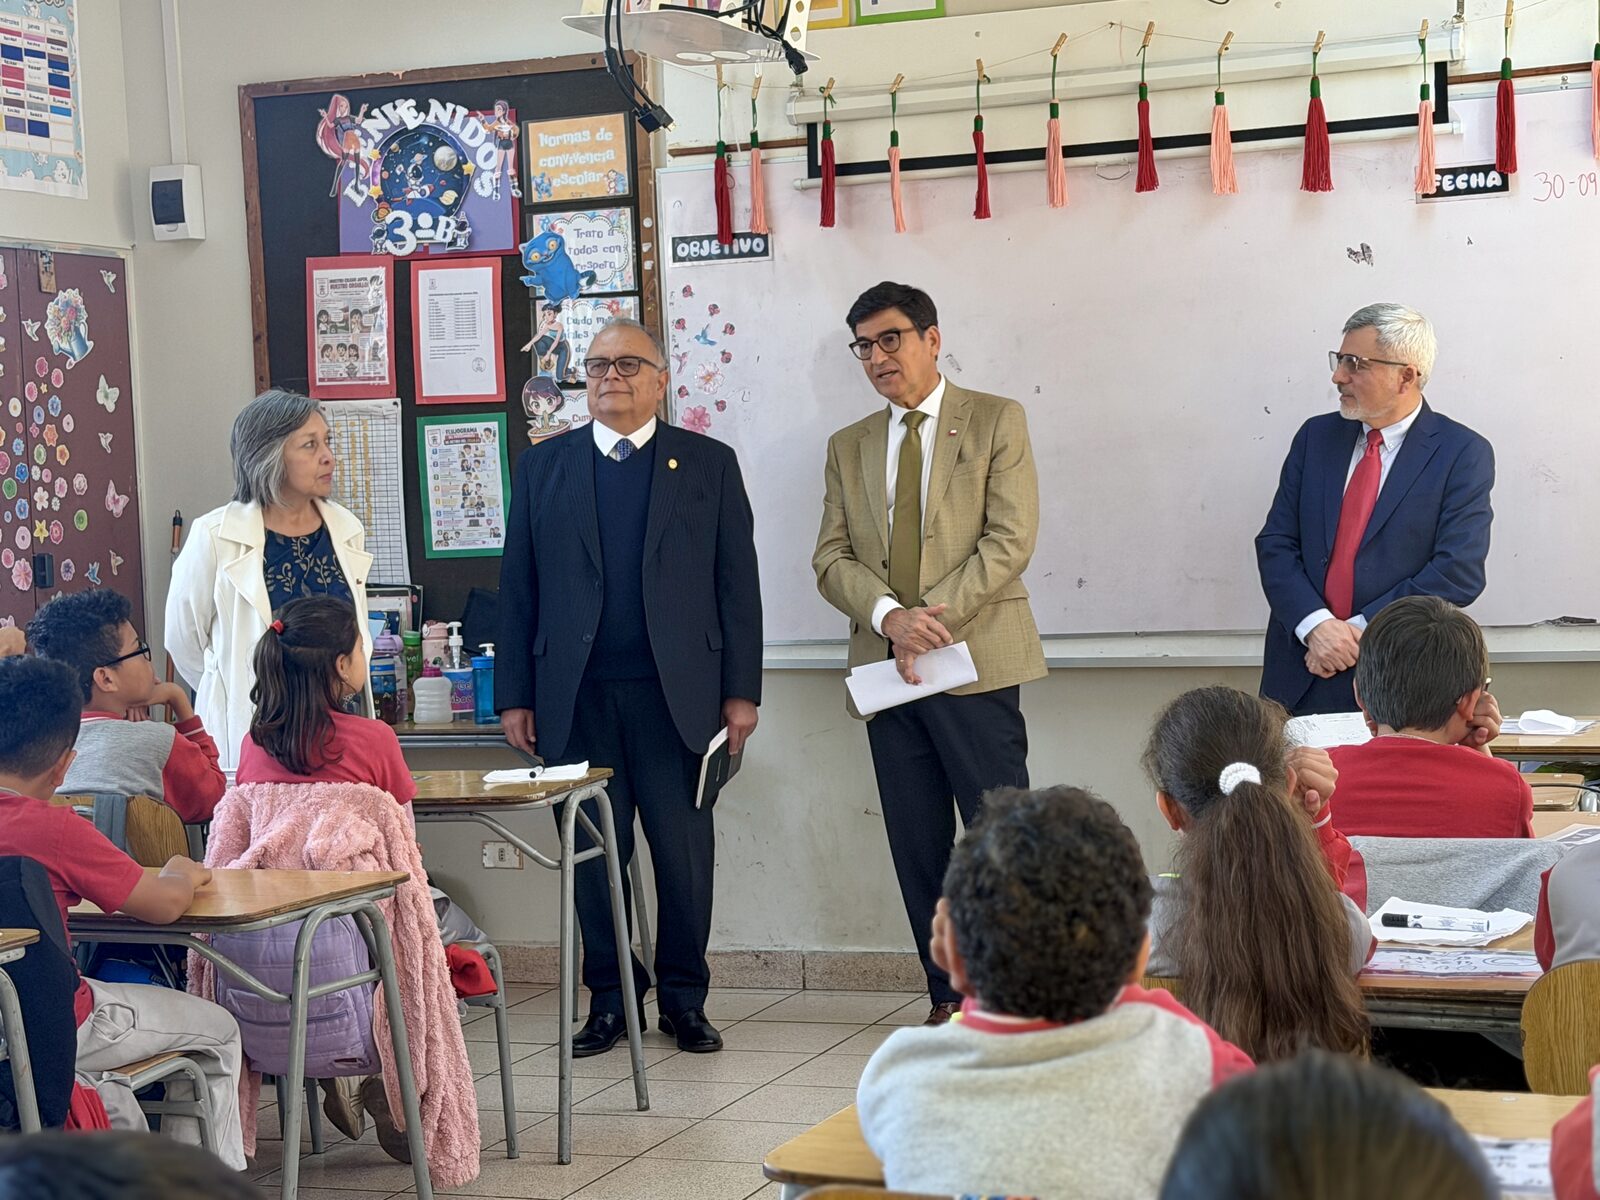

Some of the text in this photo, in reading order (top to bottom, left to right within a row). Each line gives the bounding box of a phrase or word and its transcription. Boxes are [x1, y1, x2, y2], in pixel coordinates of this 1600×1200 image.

[538, 127, 613, 147] Normas de
[539, 149, 615, 168] convivencia
[1533, 171, 1598, 202] 30-09
[573, 227, 604, 239] Trato
[568, 244, 622, 256] todos con
